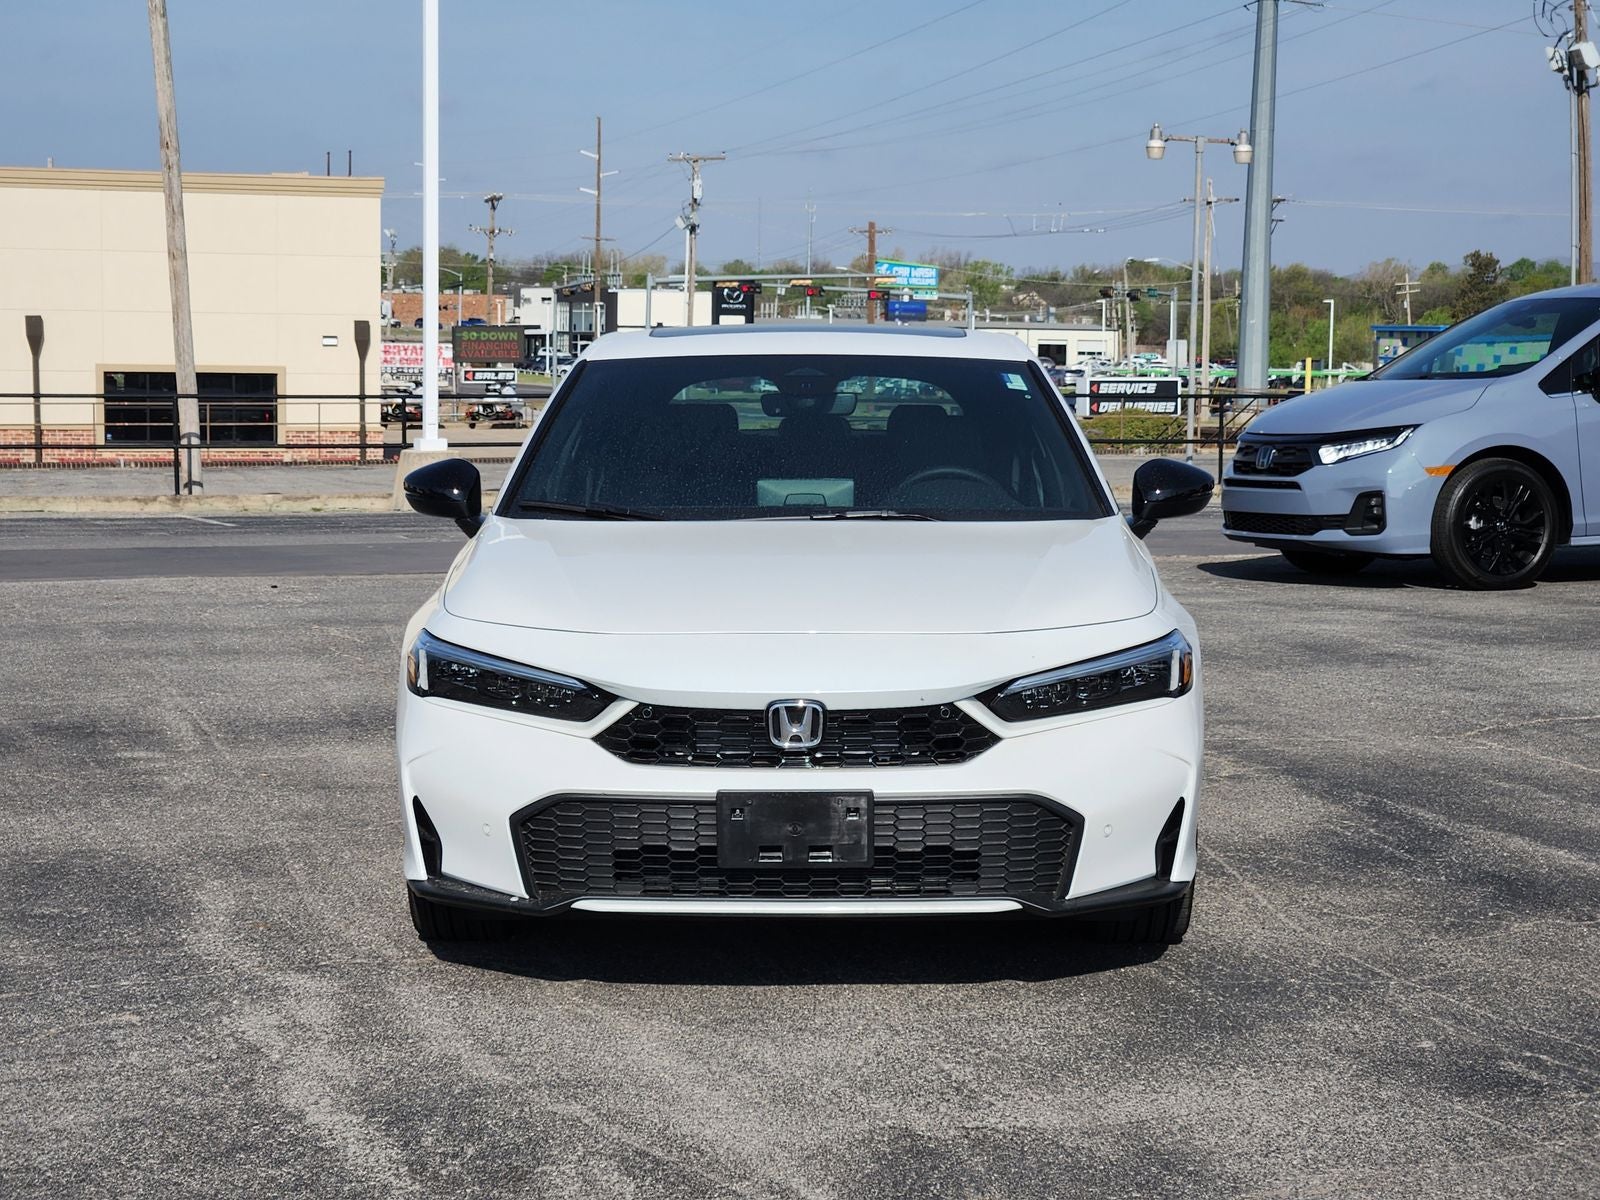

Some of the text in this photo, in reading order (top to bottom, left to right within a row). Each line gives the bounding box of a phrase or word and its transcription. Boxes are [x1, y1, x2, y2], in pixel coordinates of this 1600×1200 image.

[480, 331, 518, 341] DOWN
[461, 342, 519, 350] FINANCING
[459, 350, 520, 358] AVAILABLE!
[473, 371, 515, 380] SALES
[1098, 382, 1157, 395] SERVICE
